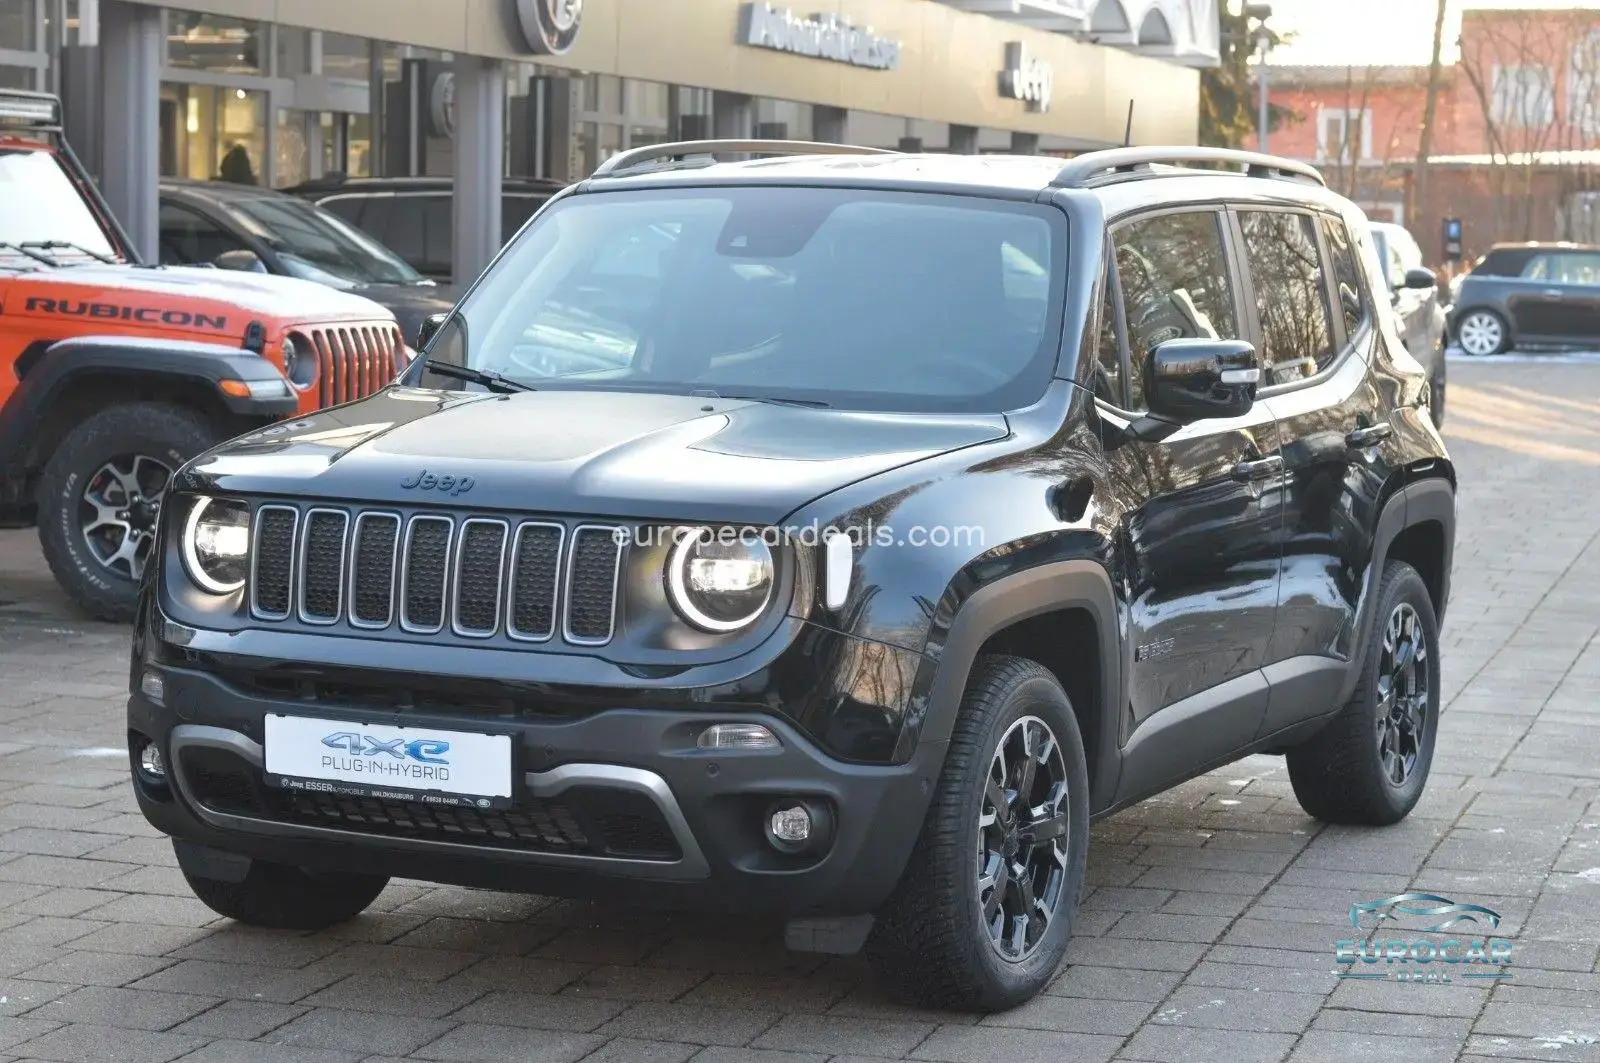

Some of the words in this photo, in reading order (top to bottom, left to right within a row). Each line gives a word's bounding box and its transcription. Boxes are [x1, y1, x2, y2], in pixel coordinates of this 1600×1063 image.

[25, 297, 226, 329] RUBICON
[400, 468, 477, 497] Jeep
[322, 755, 450, 781] PLUG-IN-HYBRID
[305, 781, 333, 792] ESSER
